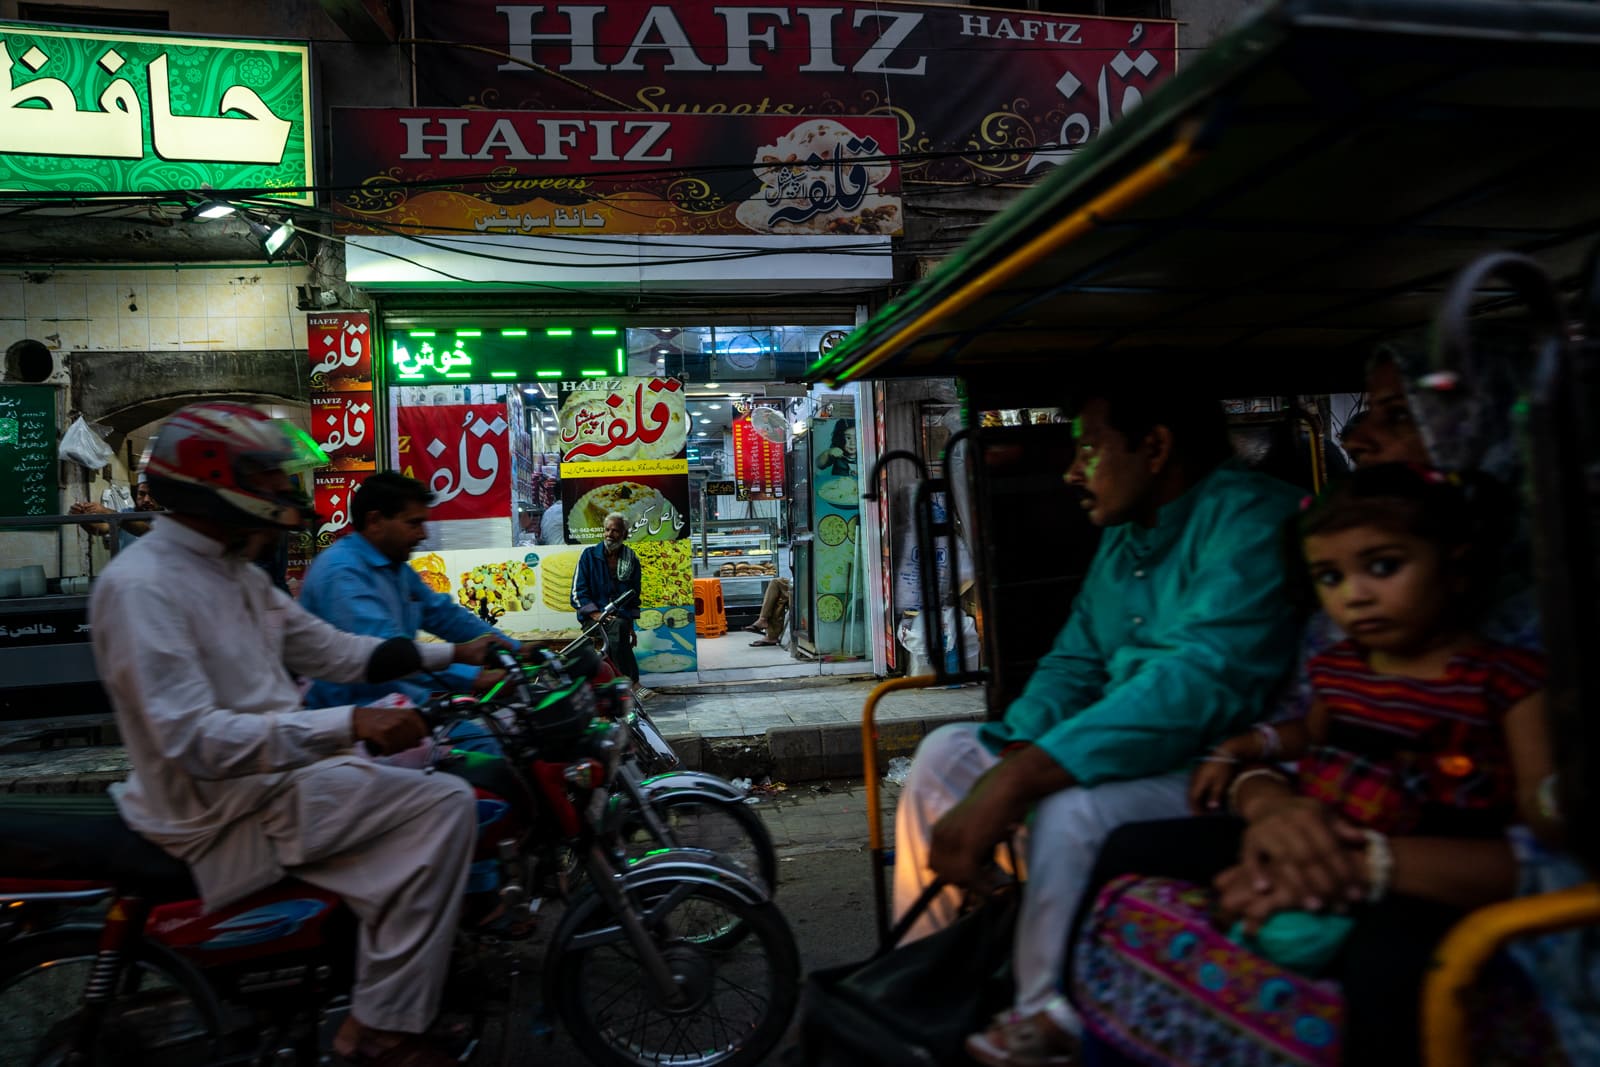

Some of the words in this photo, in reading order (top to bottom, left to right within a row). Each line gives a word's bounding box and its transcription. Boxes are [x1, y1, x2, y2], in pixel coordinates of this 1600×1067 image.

[495, 4, 928, 77] HAFIZ
[959, 14, 1083, 45] HAFIZ
[0, 42, 292, 164] حافظ
[398, 118, 674, 162] HAFIZ
[485, 166, 594, 195] Sweets
[474, 207, 551, 233] سویٹس
[553, 207, 606, 228] حافظ
[309, 318, 339, 326] HAFIZ
[561, 380, 622, 392] HAFIZ
[316, 477, 345, 485] HAFIZ
